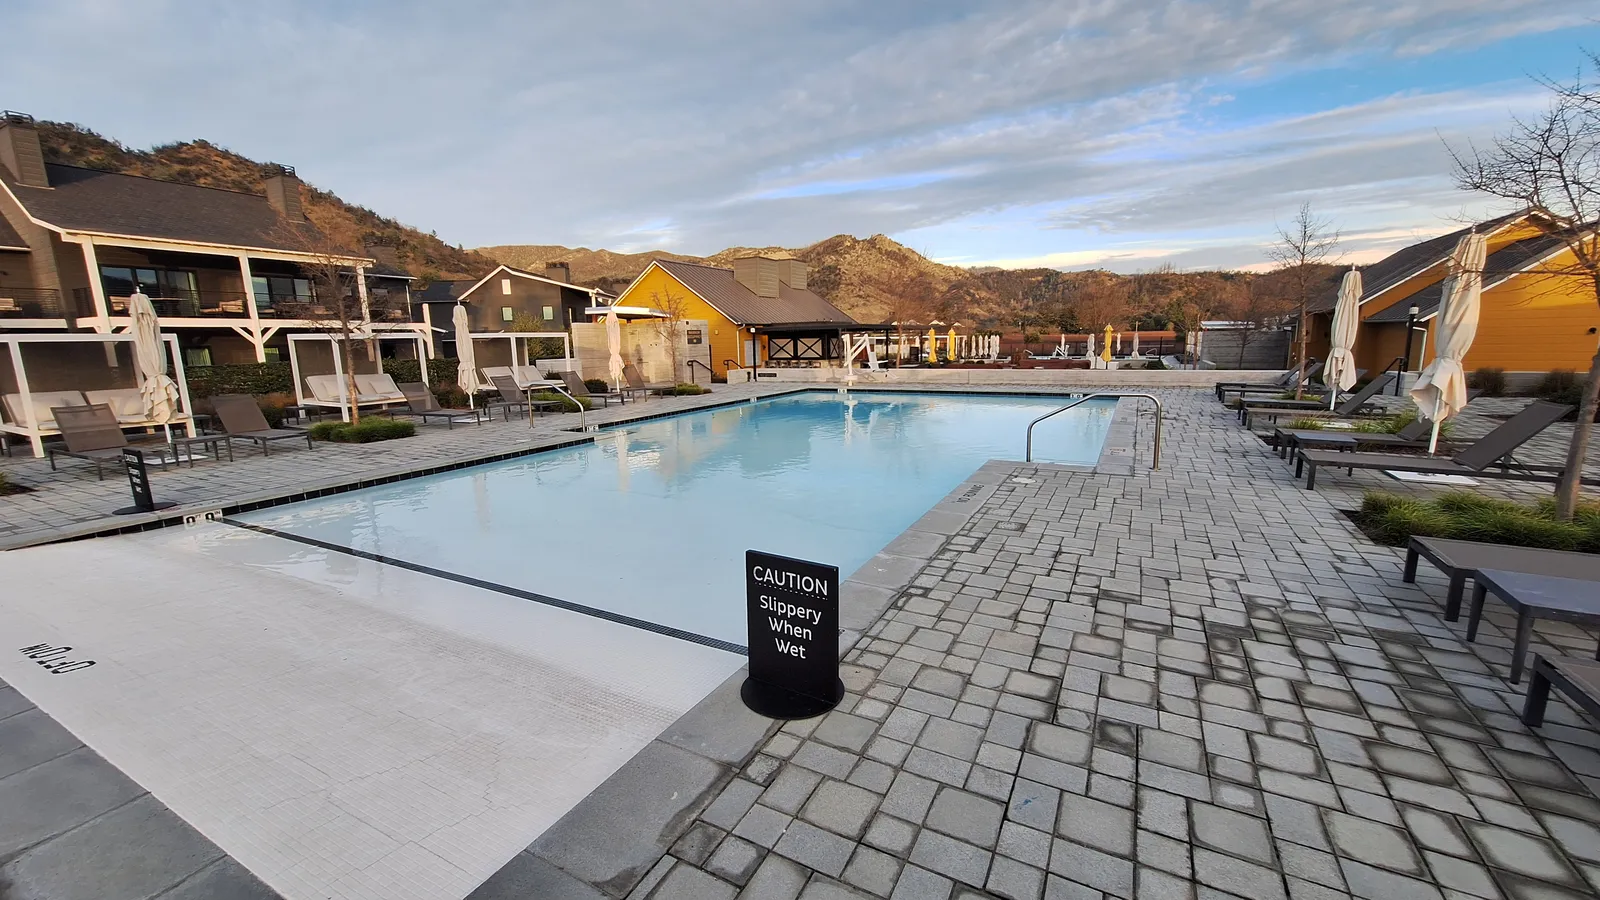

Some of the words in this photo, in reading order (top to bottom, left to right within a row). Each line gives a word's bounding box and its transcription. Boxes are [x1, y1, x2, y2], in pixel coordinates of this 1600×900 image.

[753, 566, 828, 596] CAUTION
[760, 595, 822, 625] Slippery
[768, 616, 812, 641] When
[775, 638, 807, 659] Wet
